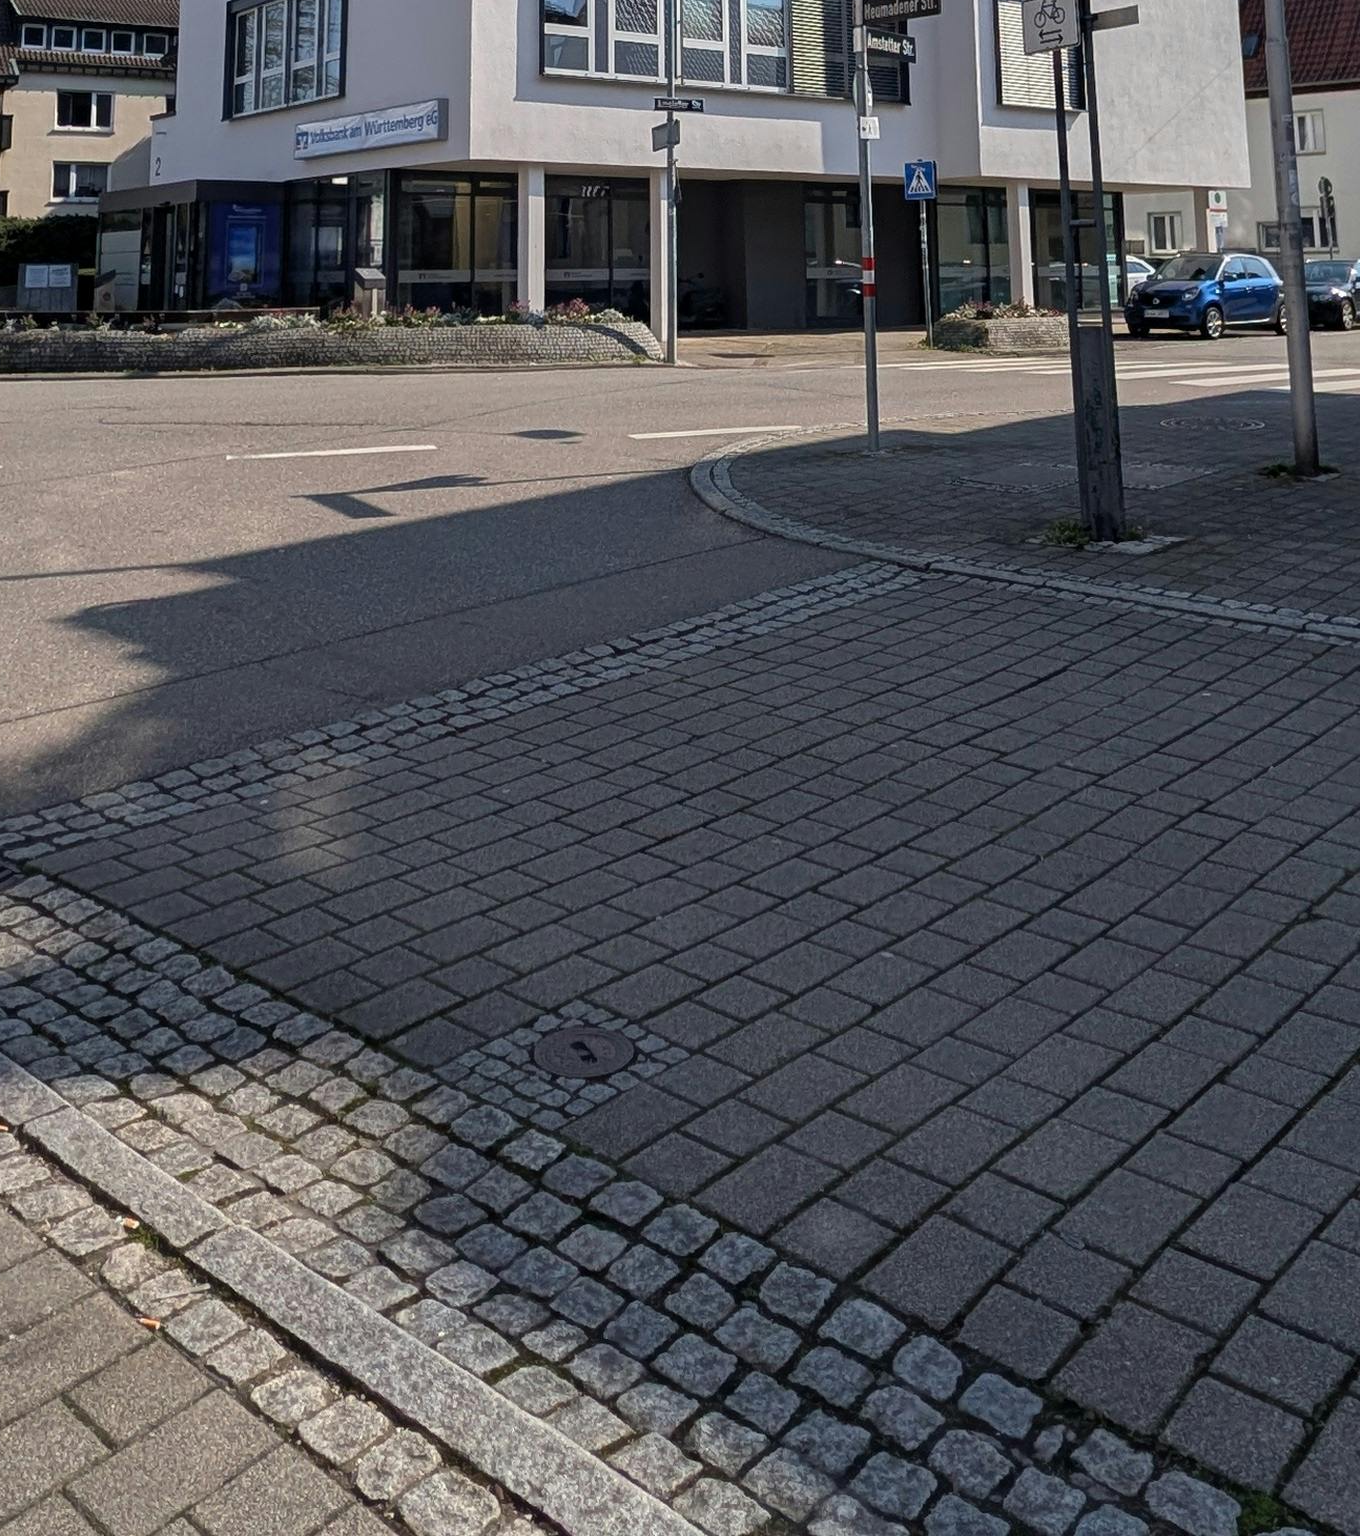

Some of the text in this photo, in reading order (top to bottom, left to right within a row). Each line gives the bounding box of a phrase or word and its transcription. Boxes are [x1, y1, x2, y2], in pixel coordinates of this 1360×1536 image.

[902, 39, 915, 57] Str.
[310, 111, 439, 144] Volksbank am Württemberg eG
[155, 157, 162, 177] 2
